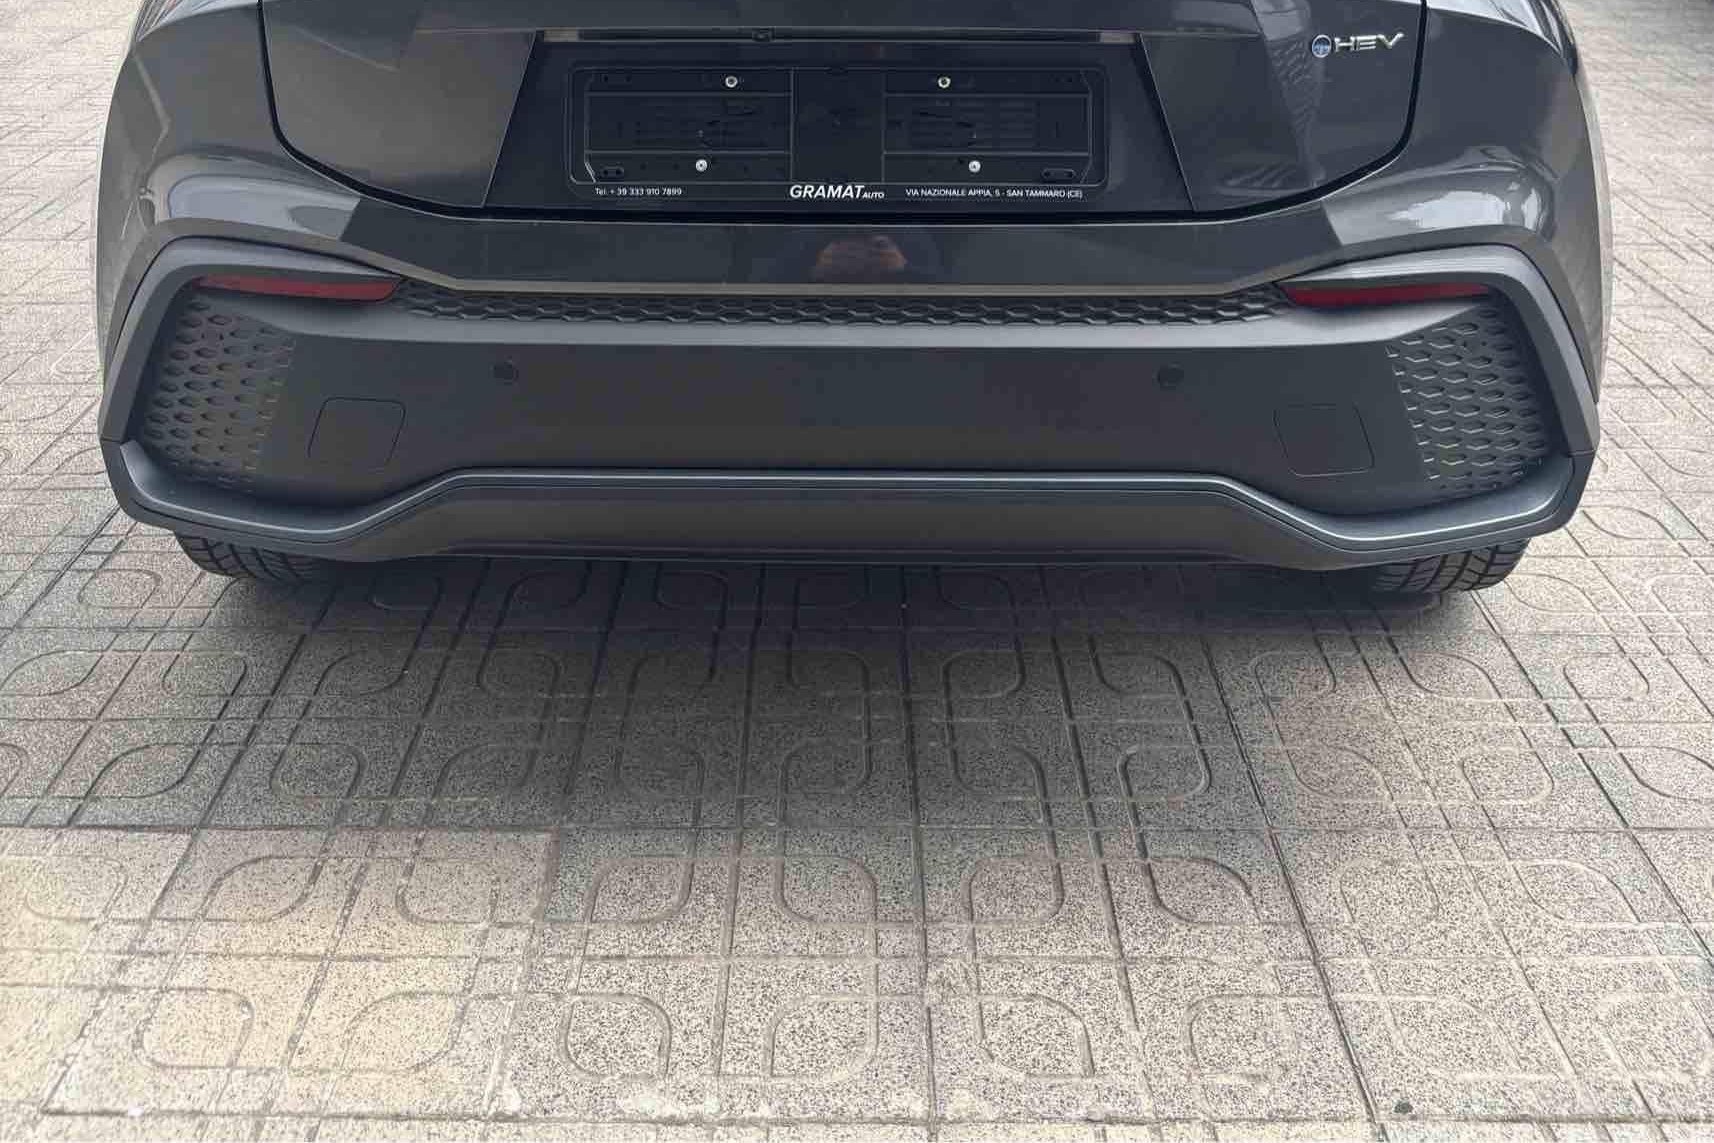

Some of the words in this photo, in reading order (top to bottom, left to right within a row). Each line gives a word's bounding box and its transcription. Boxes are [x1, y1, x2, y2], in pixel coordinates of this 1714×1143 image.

[1334, 33, 1404, 52] HEV
[790, 185, 865, 199] GRAMAT
[905, 188, 920, 197] VIA
[921, 188, 966, 197] NAZIONALE
[1006, 189, 1024, 198] SAN
[1025, 189, 1066, 198] TAMMARO
